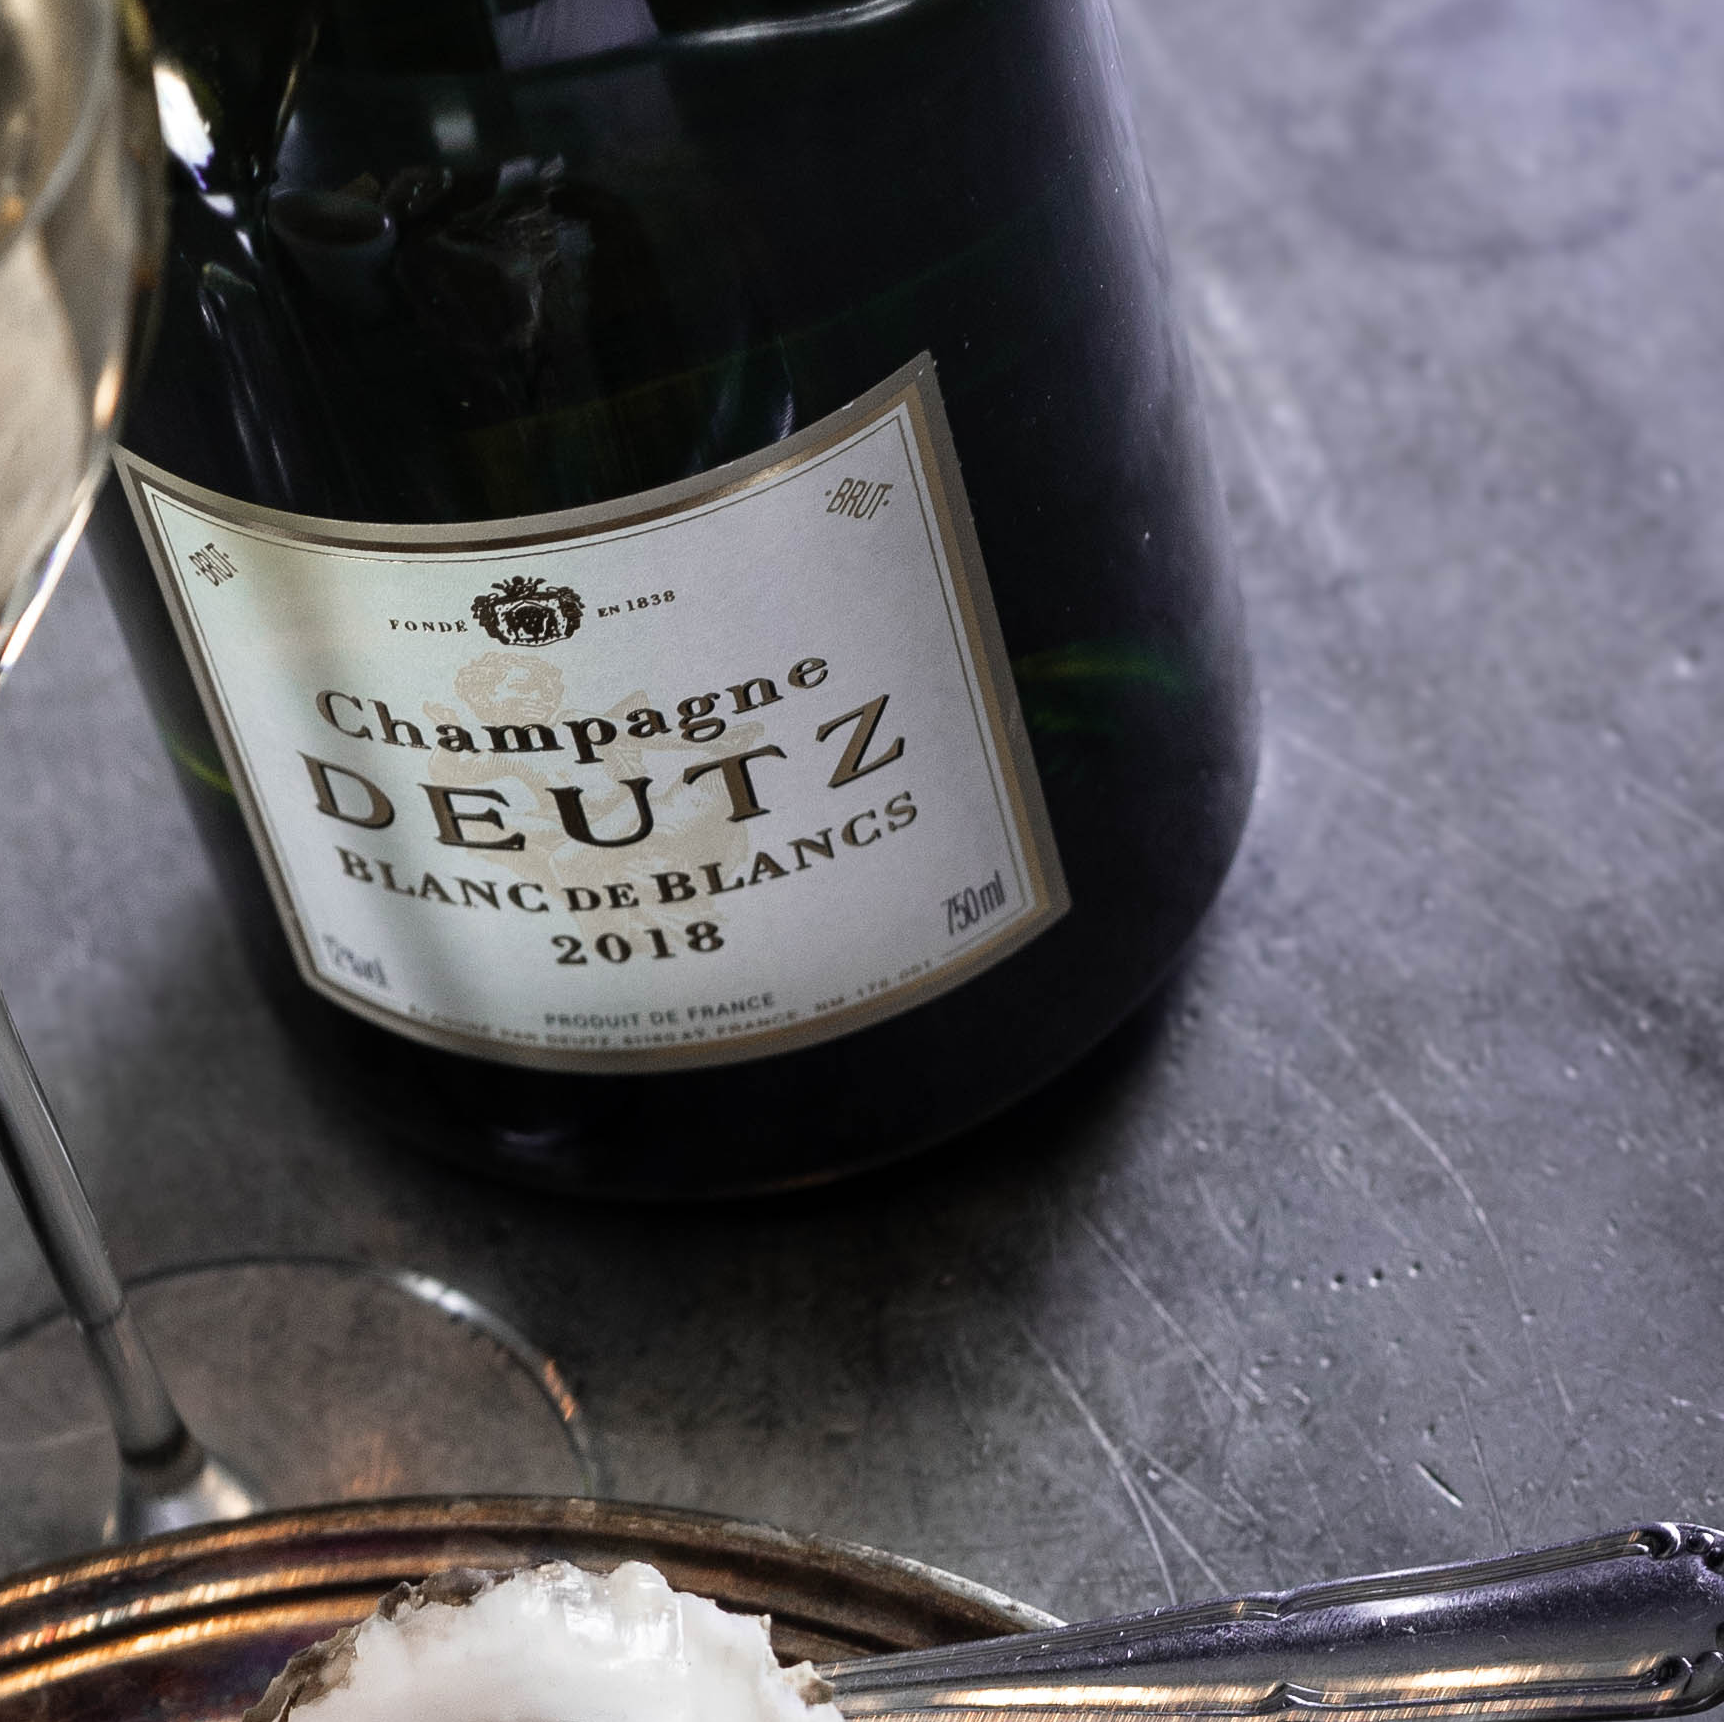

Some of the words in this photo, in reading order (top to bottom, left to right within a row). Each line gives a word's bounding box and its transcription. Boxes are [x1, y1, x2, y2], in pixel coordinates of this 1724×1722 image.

[825, 477, 894, 520] BRUT
[597, 604, 621, 618] EN
[625, 589, 676, 612] 1838
[314, 656, 830, 764] Champagne
[297, 693, 906, 852] DEUTZ
[335, 845, 550, 913] BLANC
[561, 881, 640, 912] DE
[656, 791, 919, 907] BLANCS
[550, 920, 726, 966] 2018
[544, 1012, 640, 1029] PRODUIT
[649, 1009, 678, 1026] DE
[686, 992, 774, 1021] FRANCE
